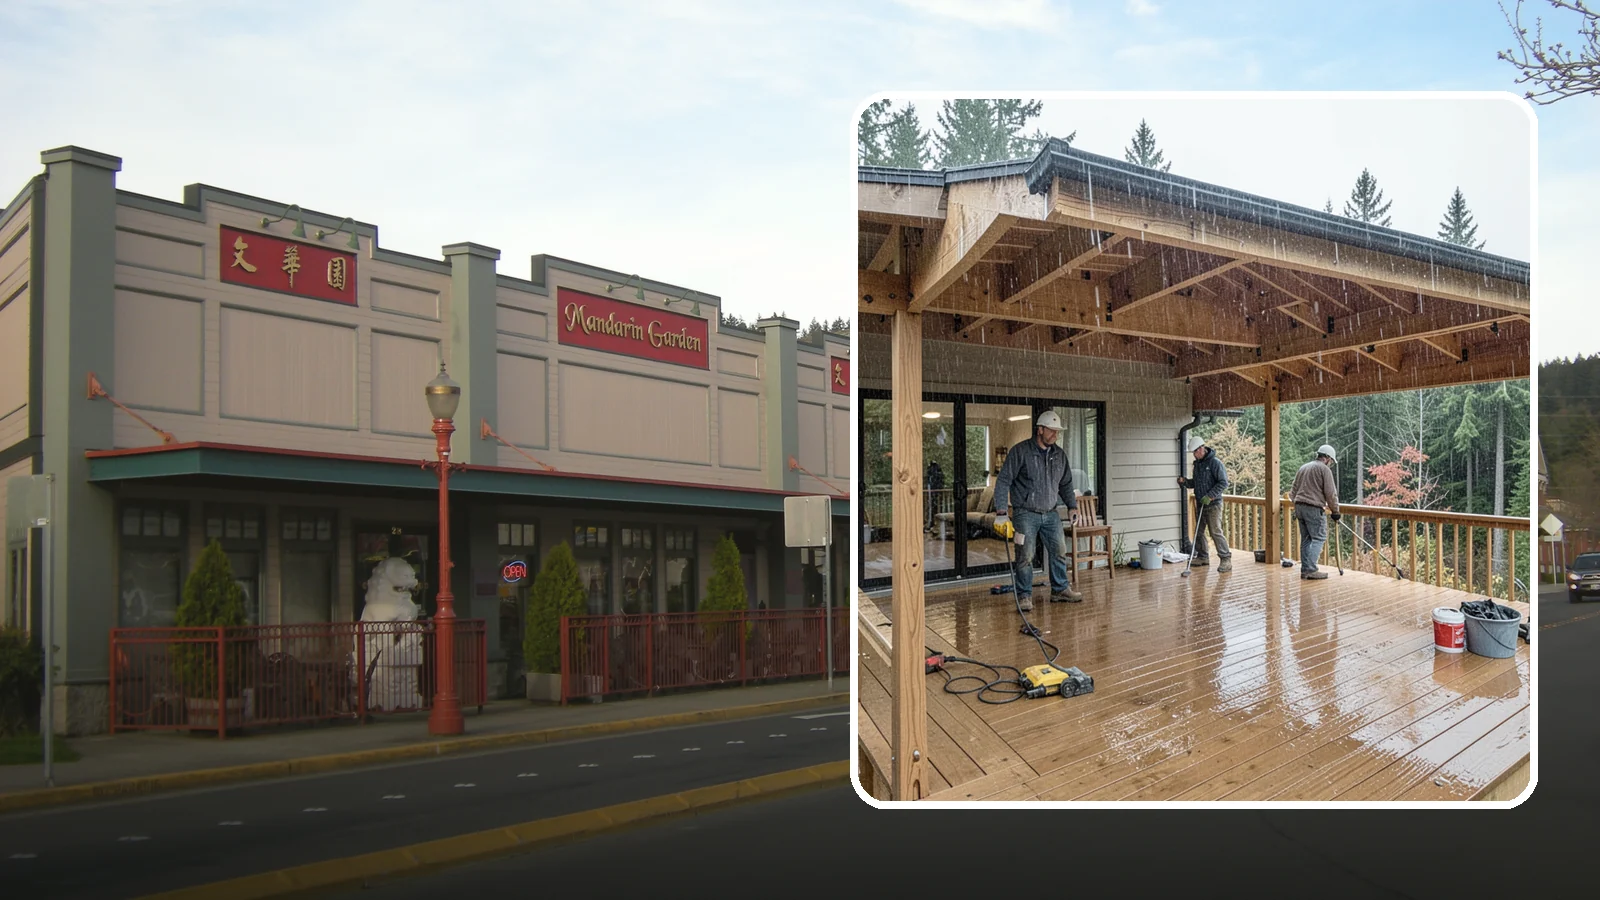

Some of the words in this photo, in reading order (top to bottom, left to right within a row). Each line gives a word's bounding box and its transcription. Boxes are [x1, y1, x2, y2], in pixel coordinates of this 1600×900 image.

[230, 235, 346, 291] 文華園
[564, 302, 644, 341] Mandarin
[647, 320, 702, 352] Garden
[503, 565, 527, 578] OPEN
